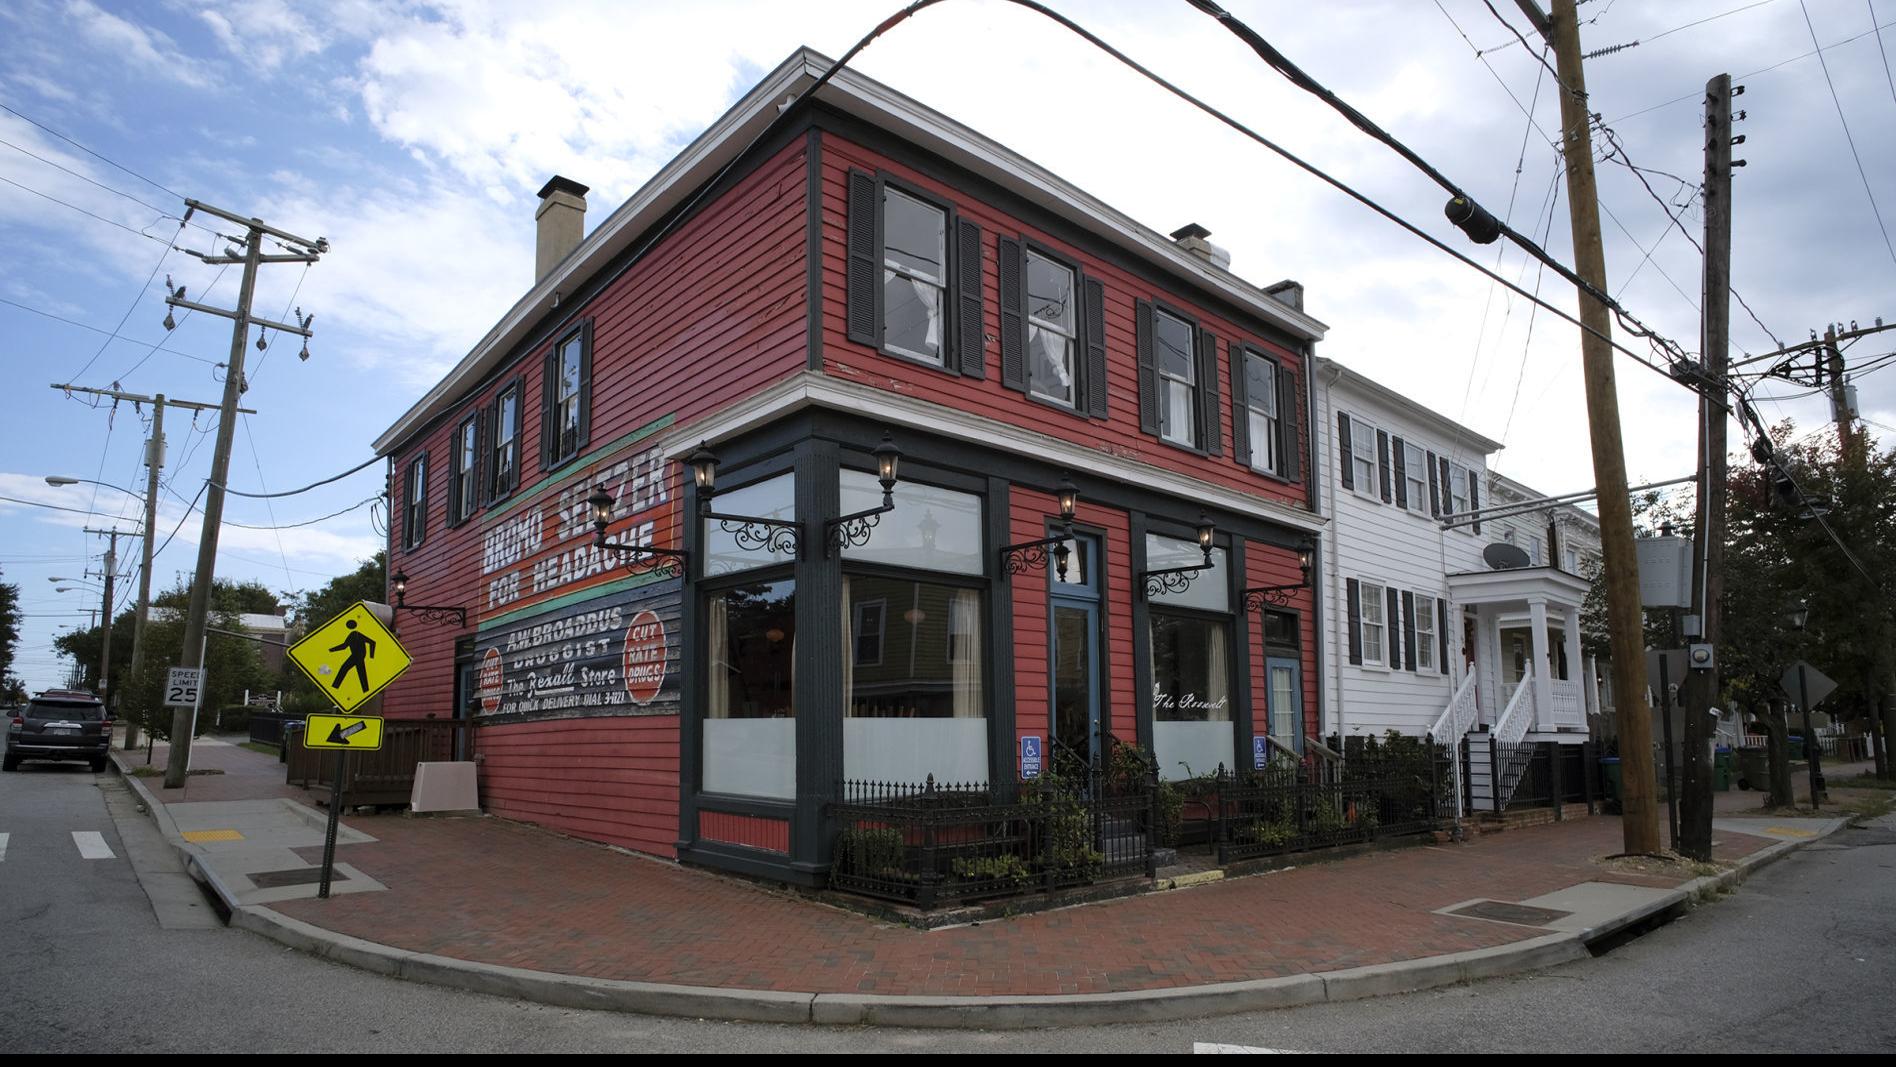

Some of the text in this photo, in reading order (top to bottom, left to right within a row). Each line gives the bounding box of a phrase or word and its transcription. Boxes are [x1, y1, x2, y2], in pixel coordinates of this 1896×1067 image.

[483, 505, 543, 575] BROMO
[487, 522, 654, 608] FOR HEADACHE
[632, 623, 658, 641] CUT
[514, 638, 611, 669] DRUGGIST
[628, 644, 658, 664] RATE
[173, 679, 198, 687] LIMIT
[507, 662, 616, 699] The Rexall Store
[628, 664, 661, 684] DRUGS
[169, 687, 197, 703] 25
[502, 702, 517, 714] FOR
[519, 699, 540, 714] QUICK
[542, 695, 581, 710] DELIVERY
[582, 692, 602, 706] DIAL
[1153, 693, 1175, 708] The
